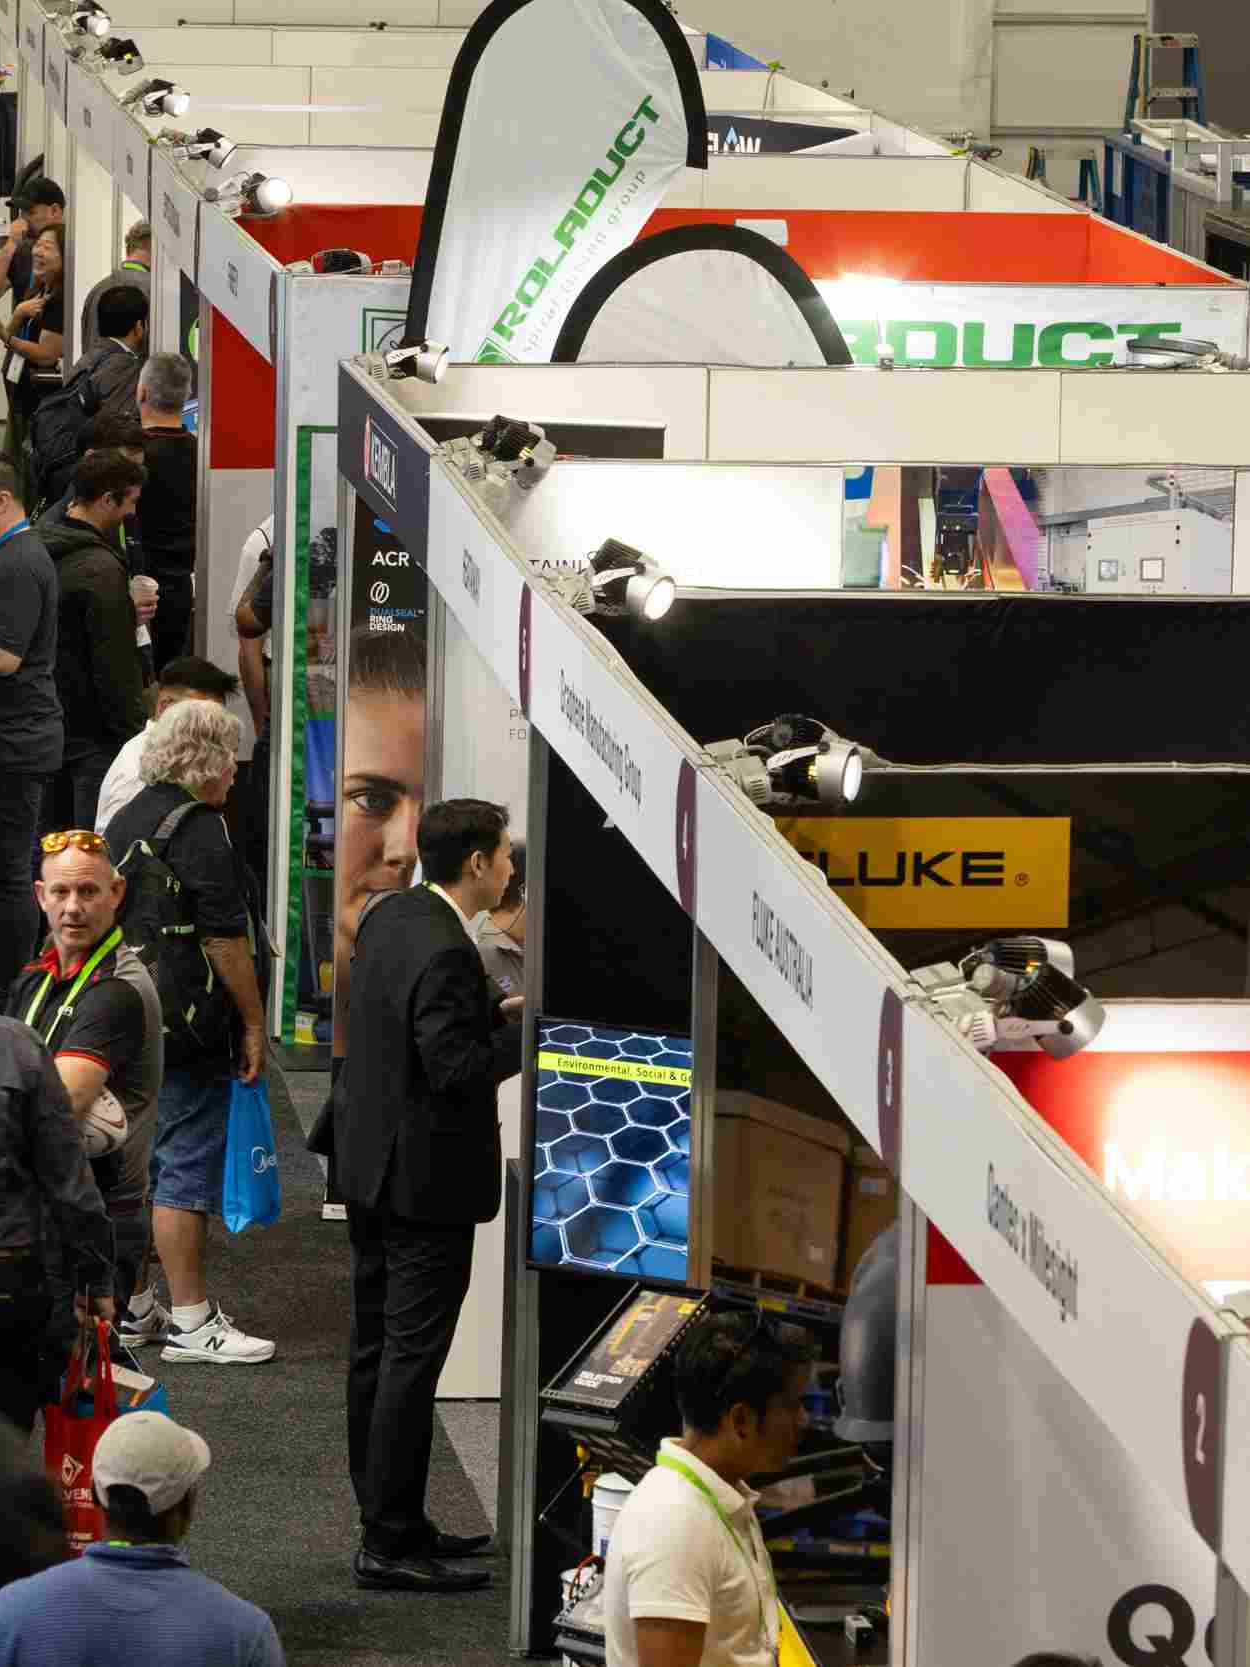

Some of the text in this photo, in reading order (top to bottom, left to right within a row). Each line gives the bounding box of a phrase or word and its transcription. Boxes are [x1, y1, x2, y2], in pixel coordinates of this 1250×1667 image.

[607, 168, 647, 226] group
[493, 95, 660, 342] ROLADUCT
[371, 550, 411, 567] ACR
[369, 616, 394, 625] RING
[369, 623, 406, 633] DESIGN
[799, 850, 1006, 887] LUKE
[751, 889, 814, 1013] FLUKE AUSTRALIA
[557, 1057, 633, 1077] Environmental,
[636, 1066, 667, 1081] Social
[1194, 1392, 1206, 1465] 2
